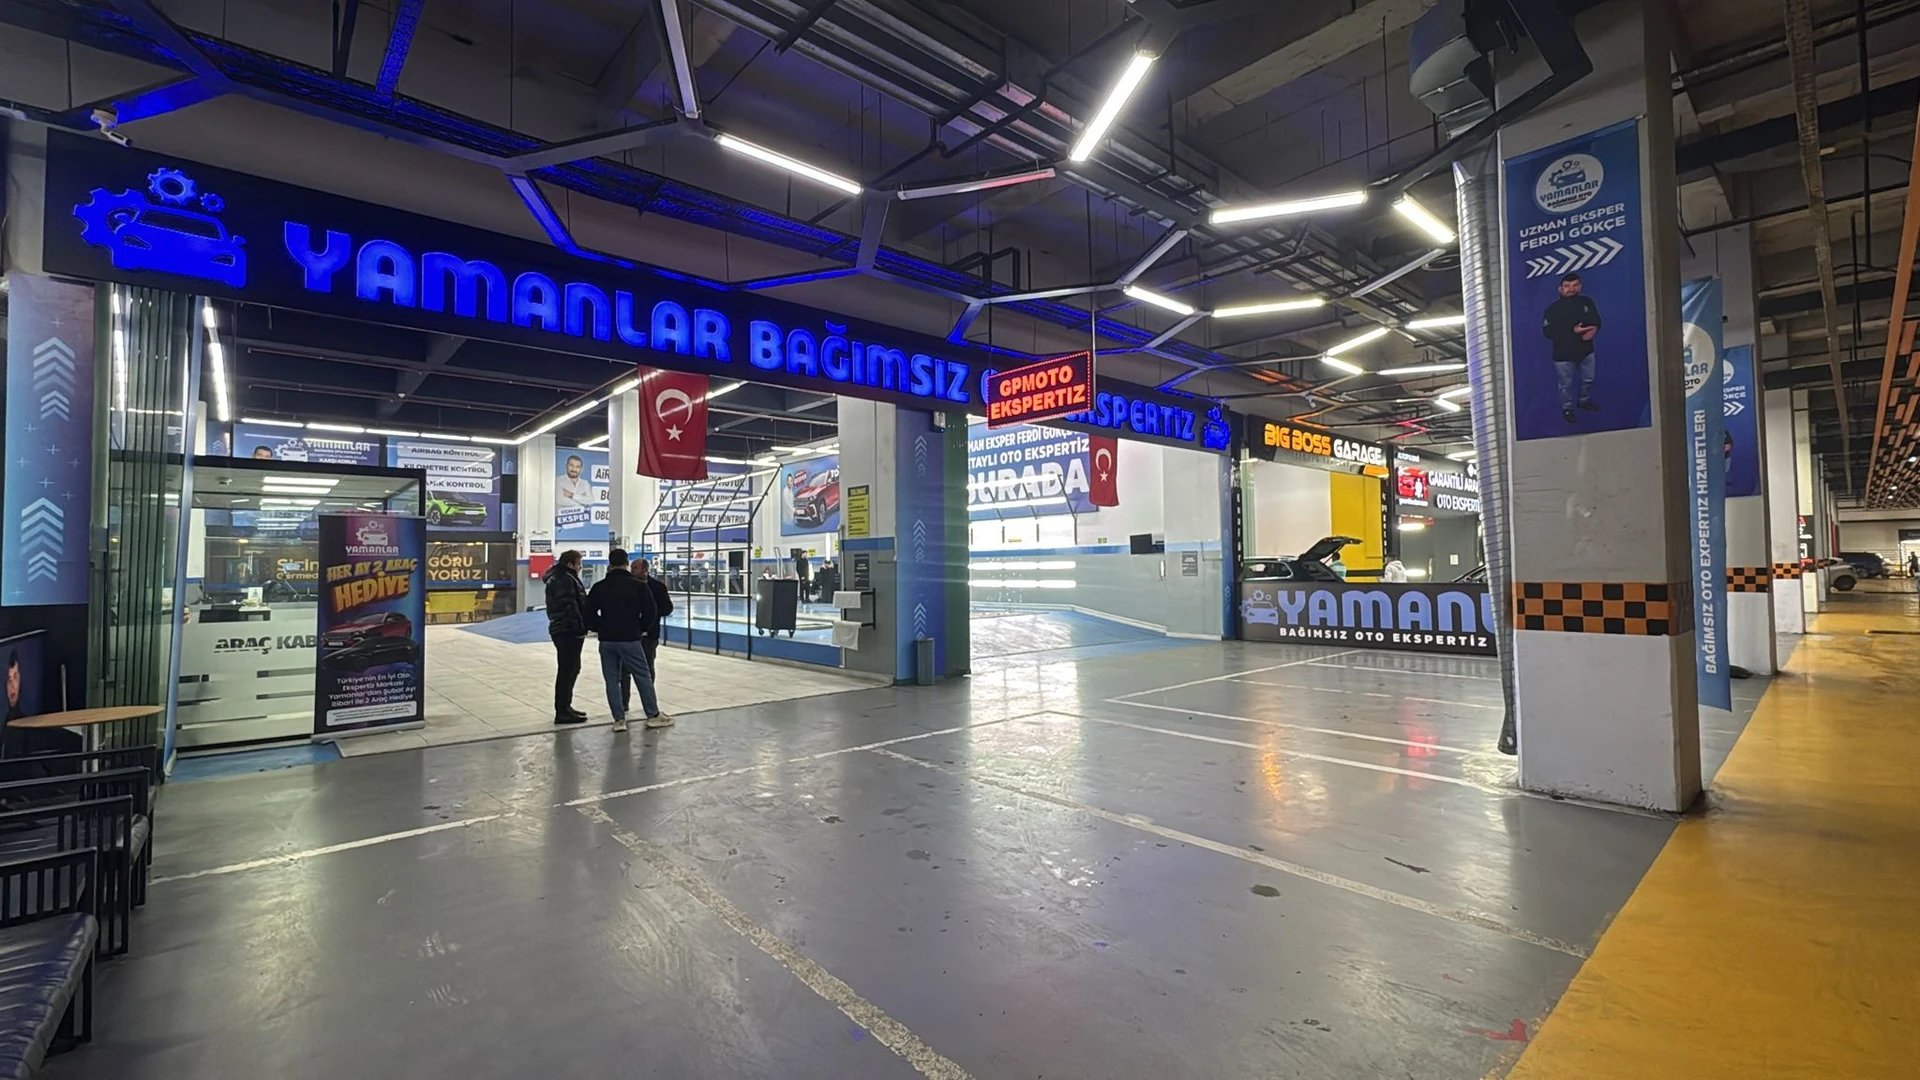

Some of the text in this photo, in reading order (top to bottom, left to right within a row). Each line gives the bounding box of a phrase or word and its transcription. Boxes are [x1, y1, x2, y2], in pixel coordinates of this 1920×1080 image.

[1540, 180, 1599, 202] YAMANLAR
[1578, 191, 1592, 200] OTO
[1520, 218, 1566, 238] UZMAN
[1570, 202, 1624, 224] EKSPER
[1568, 215, 1626, 238] GÖKÇE
[284, 220, 732, 363] YAMANLAR
[749, 319, 971, 404] BAĞIMSIZ
[1063, 391, 1196, 442] SPERTİZ
[1000, 366, 1073, 397] GPMOTO
[991, 384, 1086, 420] EKSPERTIZ
[986, 434, 1016, 450] EKSPER
[1016, 428, 1042, 445] FERDİ
[1264, 422, 1290, 448] BIG
[1292, 430, 1331, 456] BOSS
[1334, 438, 1382, 464] GARAGE
[1000, 451, 1022, 464] OTO
[1025, 438, 1090, 460] EKSPERTİZ
[1437, 494, 1452, 509] OTO
[558, 513, 590, 524] EKSPER
[346, 546, 399, 554] YAMANLAR
[1694, 410, 1718, 674] BAĞIMSIZ OTO EXPERTIZ HIZMETLERI
[354, 561, 371, 576] AY
[372, 561, 383, 572] 2
[428, 570, 482, 580] YORUZ
[334, 571, 409, 612] HEDİYE
[276, 635, 317, 650] KAB
[1280, 626, 1488, 647] BAĞIMSIZ OTO EKSPERTİZ
